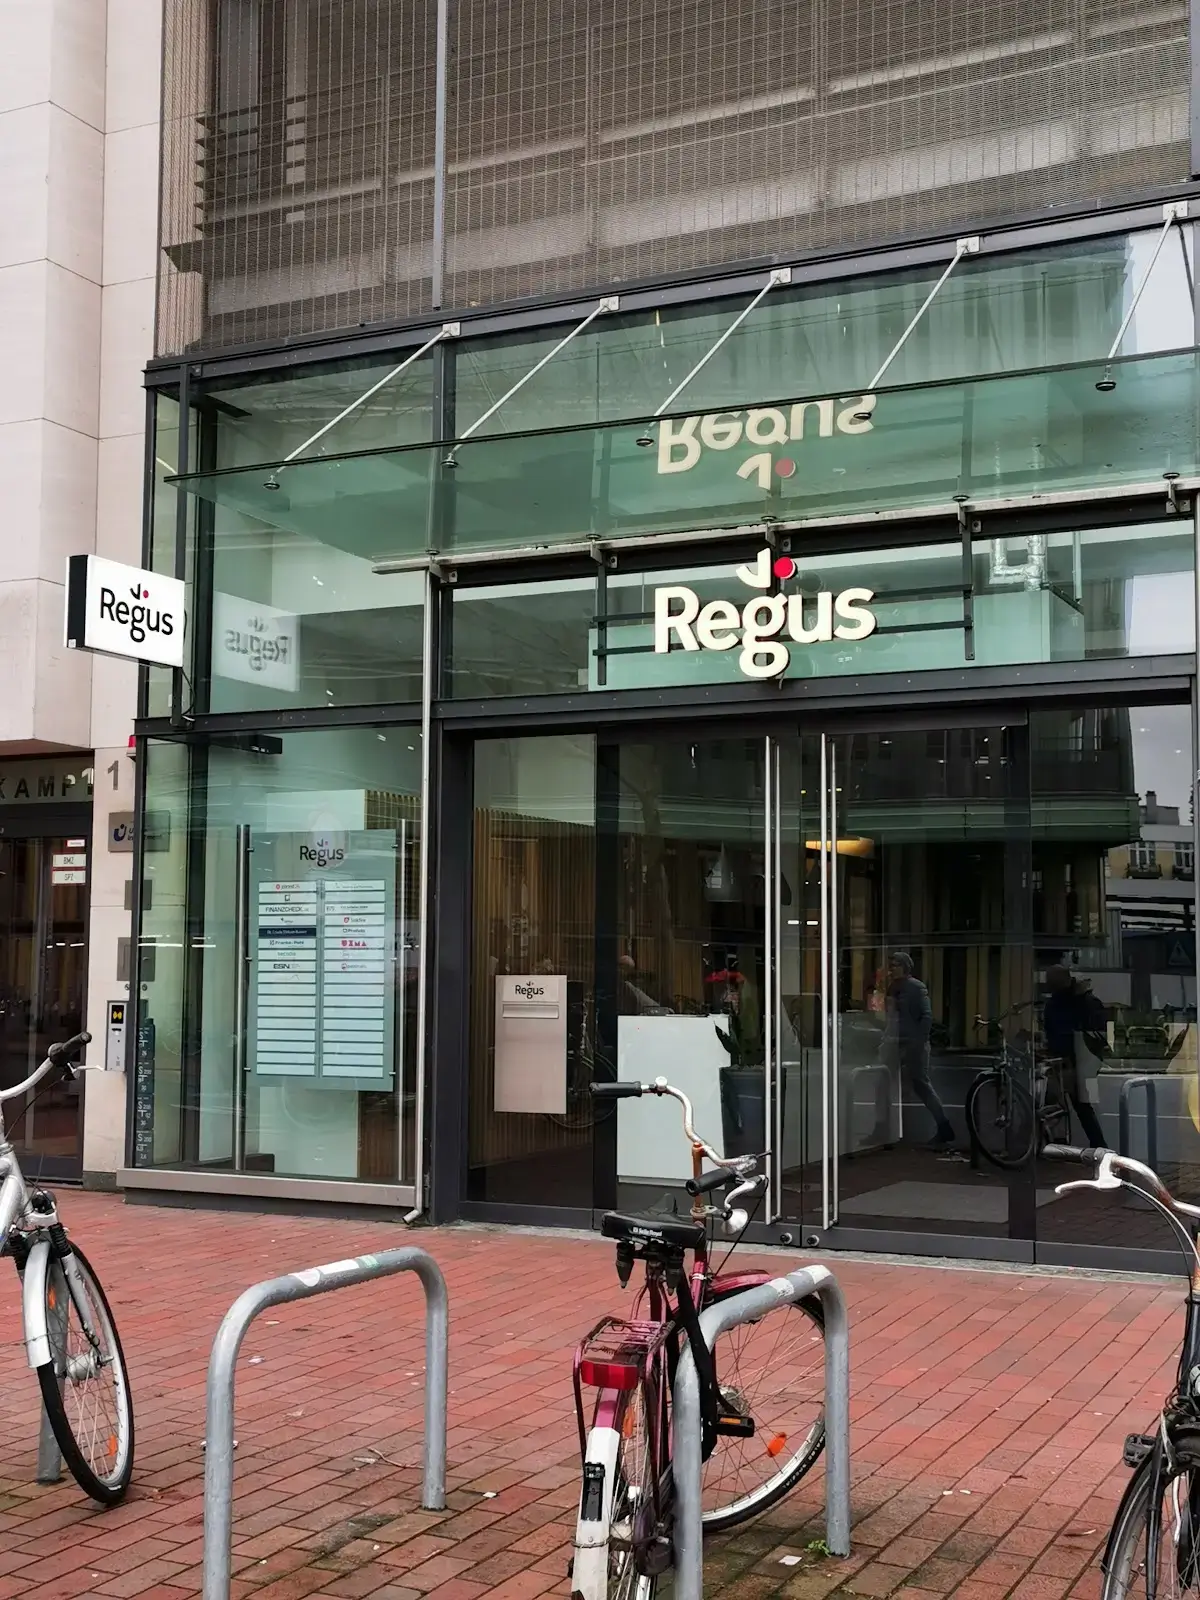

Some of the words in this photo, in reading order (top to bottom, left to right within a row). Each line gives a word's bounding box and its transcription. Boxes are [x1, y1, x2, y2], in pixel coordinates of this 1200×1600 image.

[100, 587, 174, 643] Regus
[654, 586, 877, 678] Regus
[107, 760, 119, 790] 1
[300, 845, 344, 867] Regus
[515, 984, 545, 999] Regus
